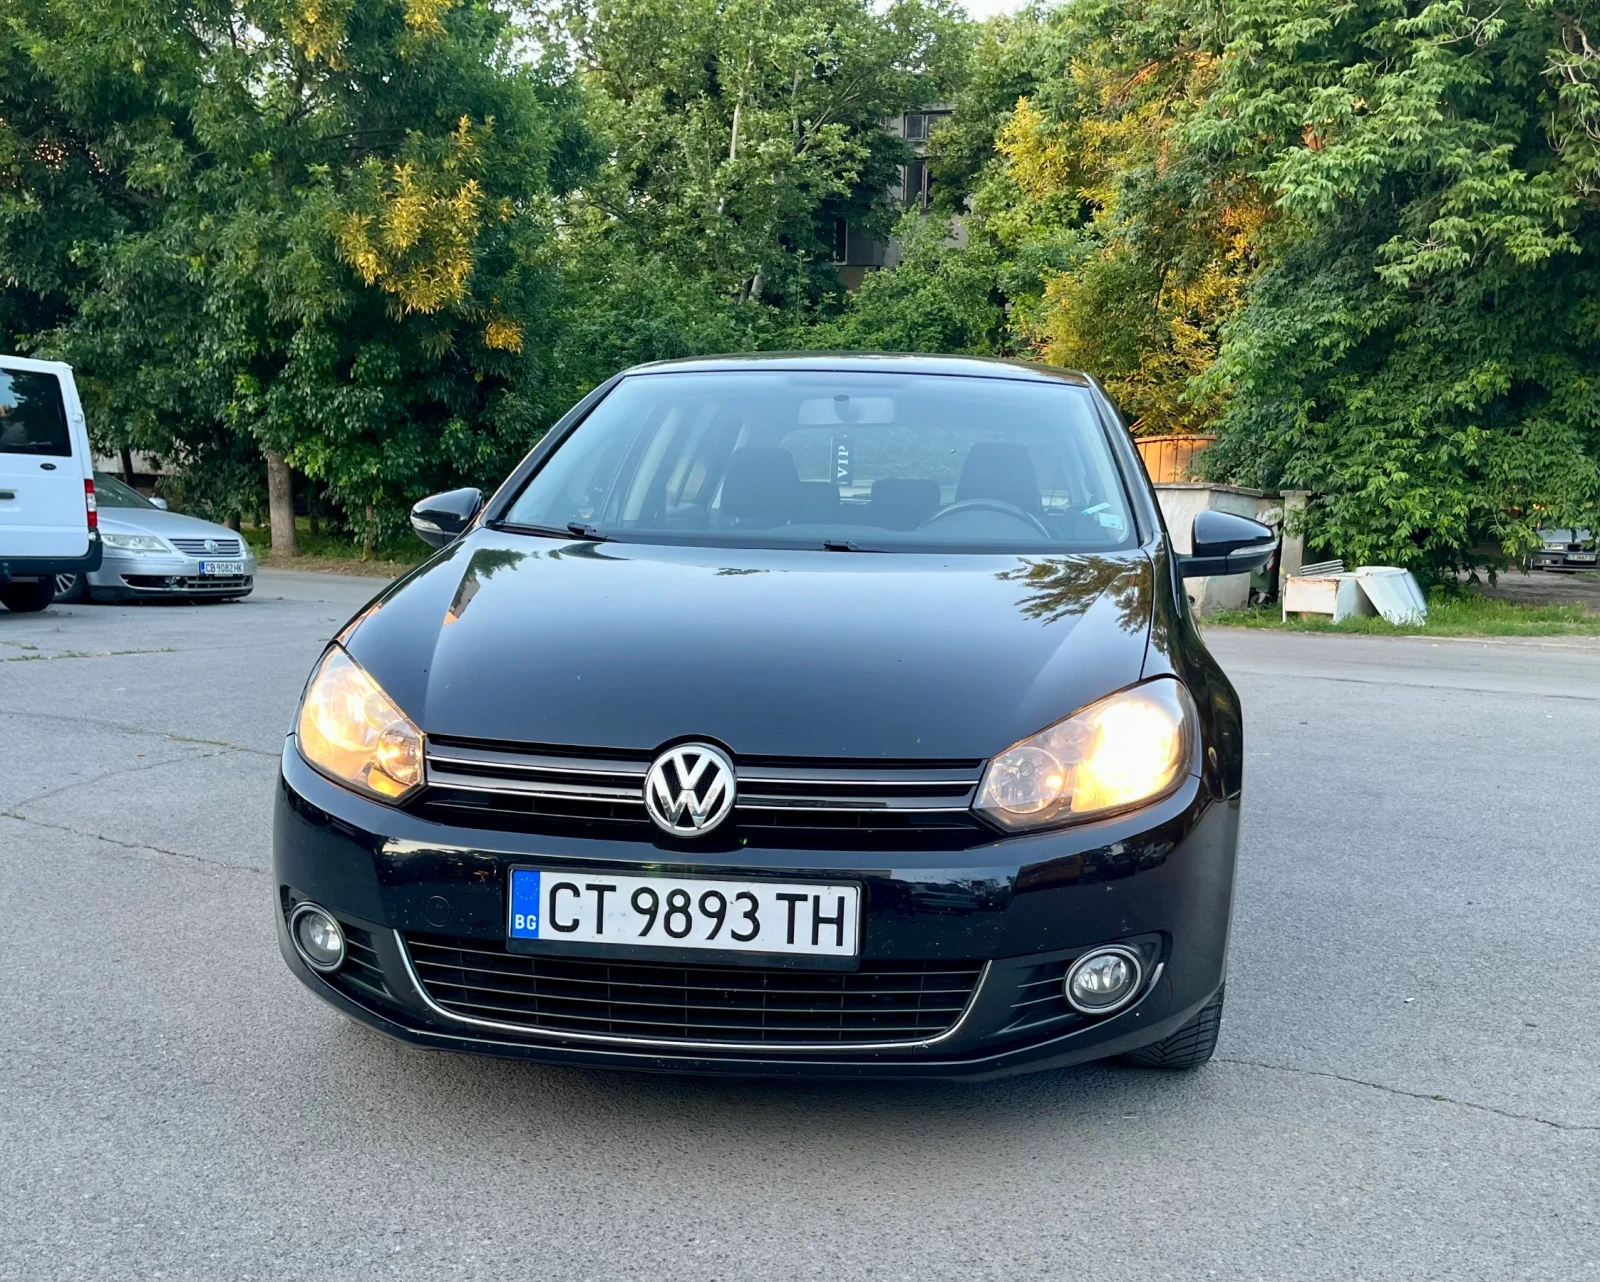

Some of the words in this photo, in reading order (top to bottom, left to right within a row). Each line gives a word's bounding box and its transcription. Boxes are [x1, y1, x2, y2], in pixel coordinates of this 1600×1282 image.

[838, 445, 849, 478] VIP
[514, 913, 537, 931] BG
[549, 881, 617, 935] CT
[630, 886, 761, 942] 9893
[775, 892, 846, 947] TH
